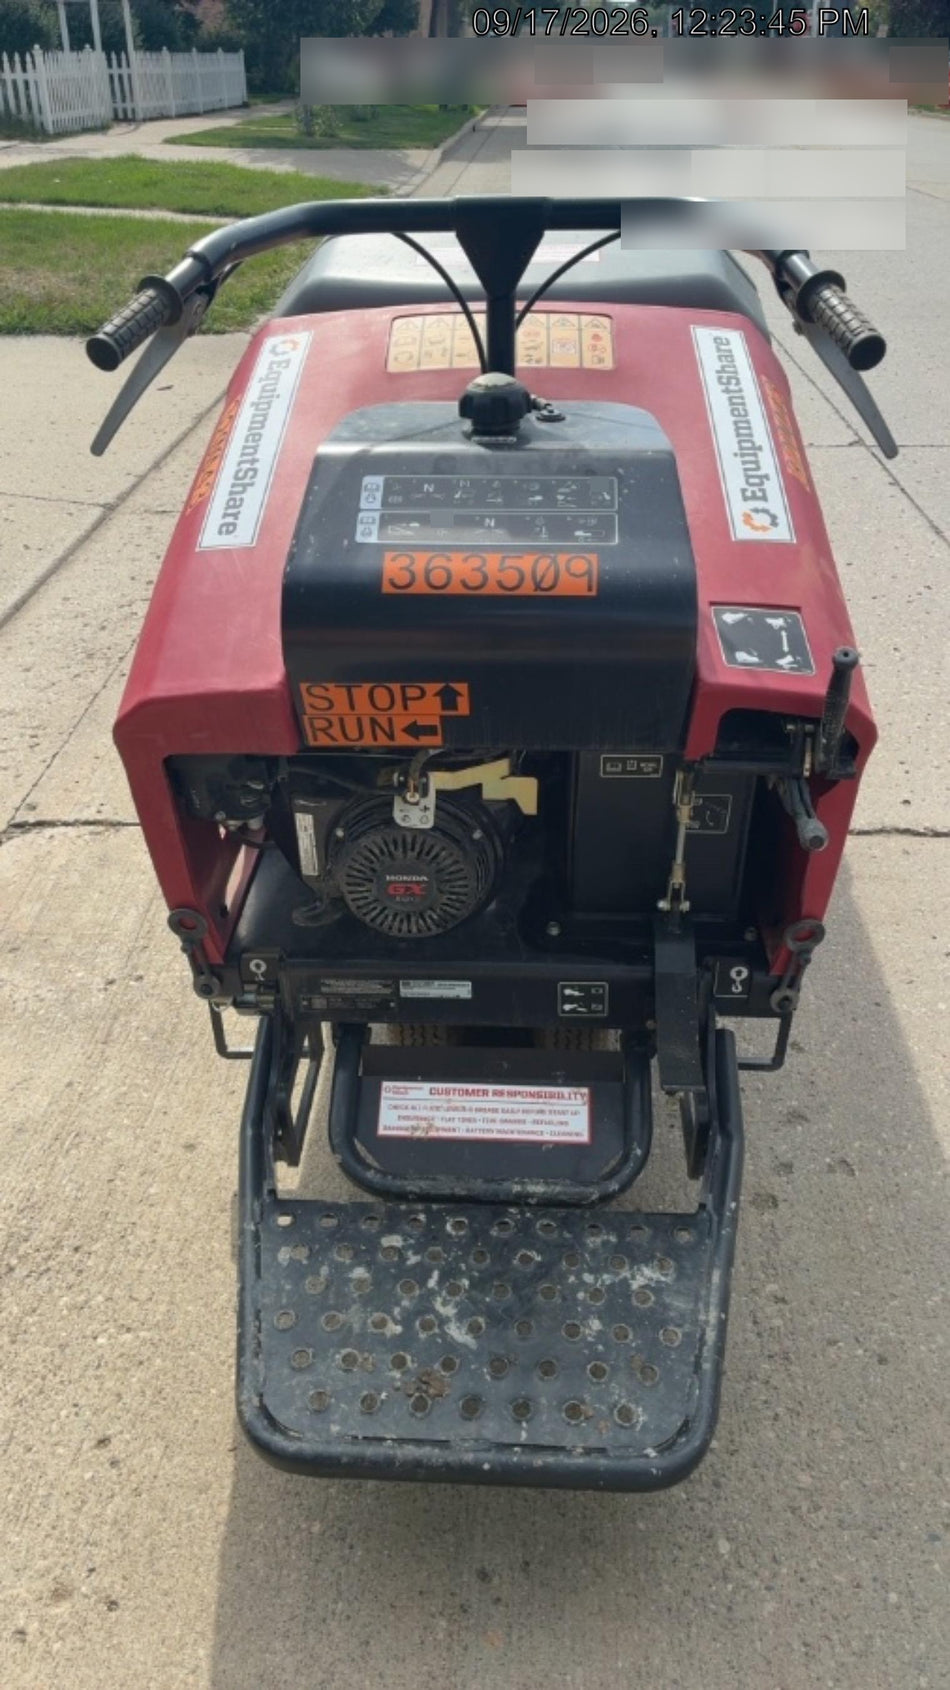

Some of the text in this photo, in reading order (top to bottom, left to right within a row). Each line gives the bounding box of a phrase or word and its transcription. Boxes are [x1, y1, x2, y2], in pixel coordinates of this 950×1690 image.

[713, 335, 770, 503] EquipmentShare
[217, 358, 292, 536] EquipmentShare
[423, 483, 435, 493] N
[484, 517, 496, 528] N
[387, 553, 594, 593] 363509
[305, 685, 427, 712] STOP
[307, 716, 396, 742] RUN
[429, 1087, 489, 1098] CUSTOMER
[491, 1088, 587, 1101] RESPONSIBILITY
